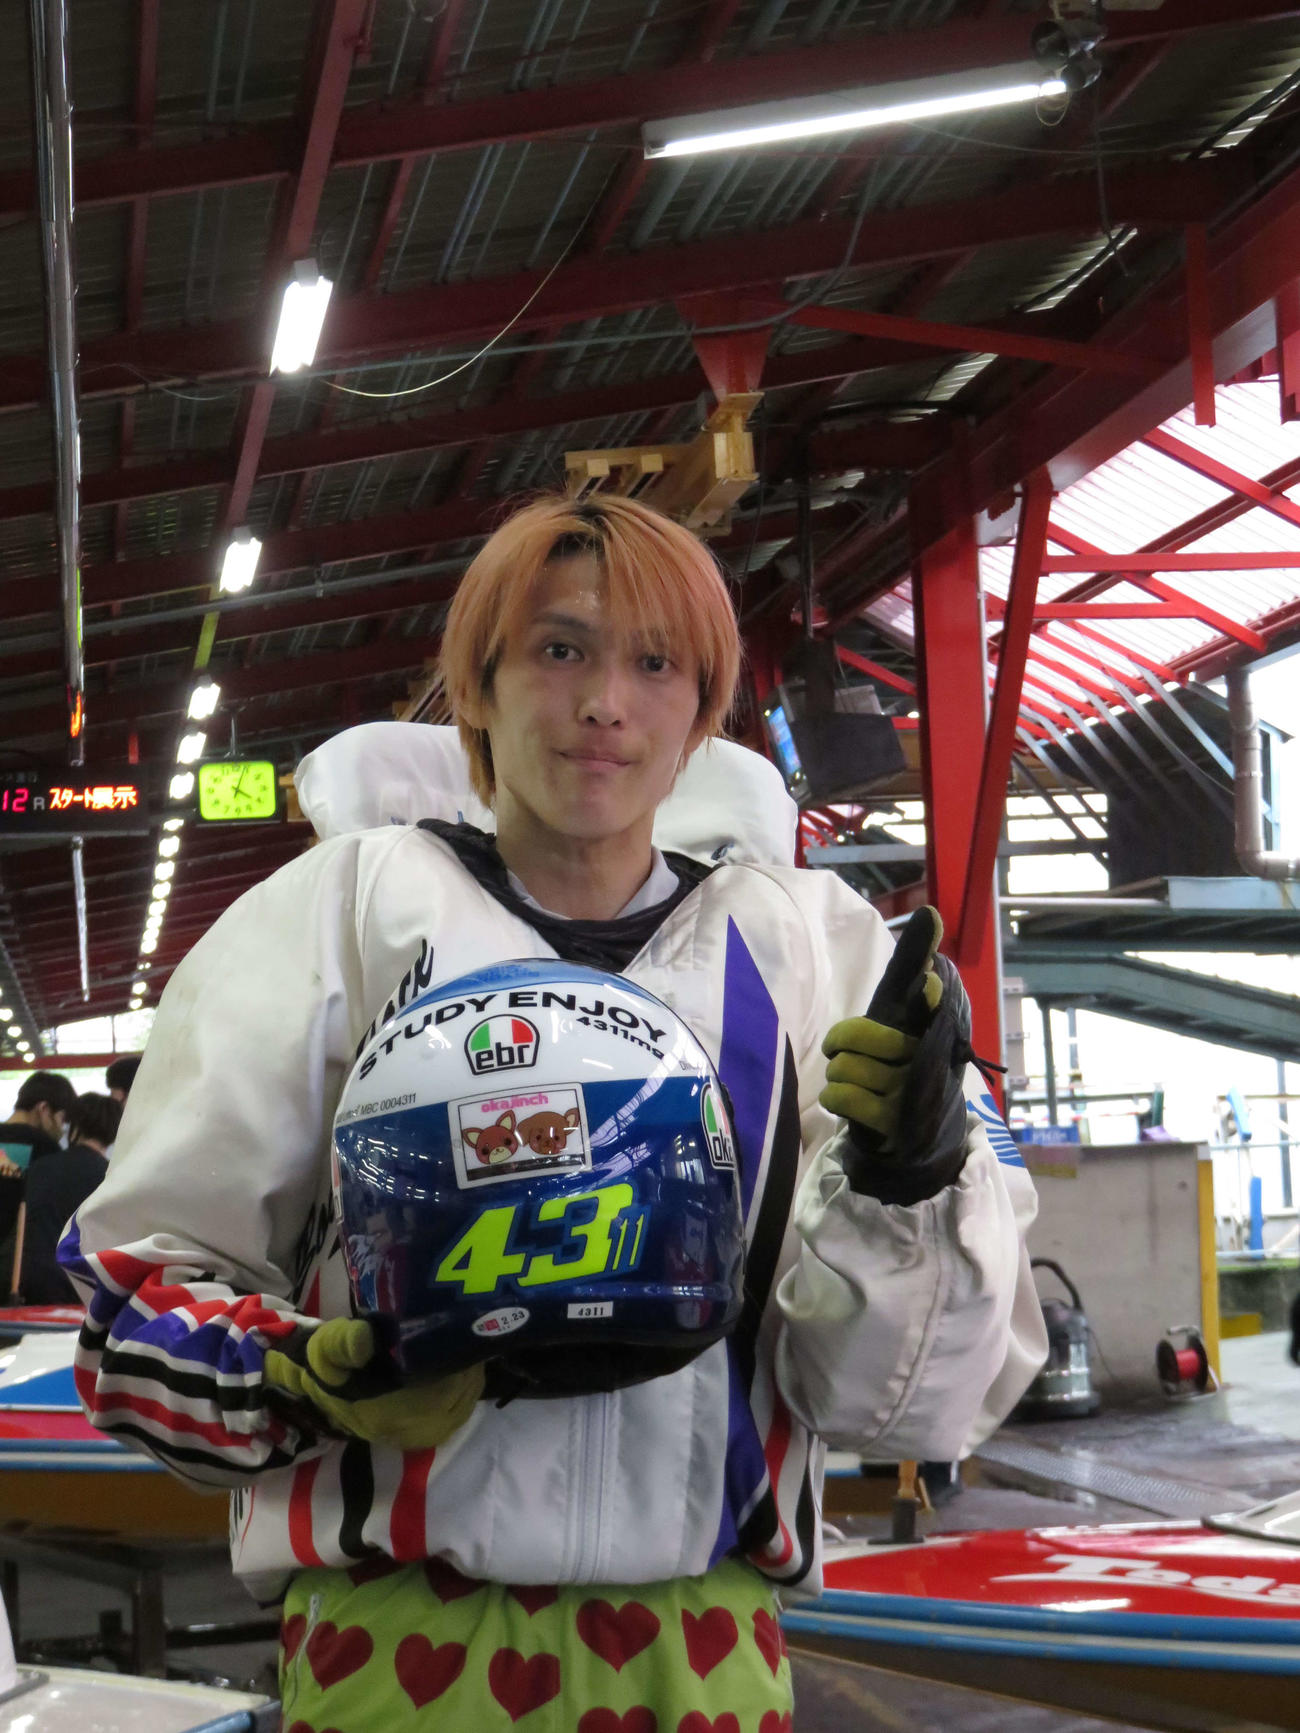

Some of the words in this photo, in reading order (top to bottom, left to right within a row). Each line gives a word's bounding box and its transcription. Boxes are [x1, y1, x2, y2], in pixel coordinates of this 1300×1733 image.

[2, 788, 29, 812] 12
[359, 994, 498, 1080] STUDY
[508, 991, 667, 1043] ENJOY
[475, 1042, 530, 1071] ebr
[481, 1093, 549, 1113] okajinch
[578, 1306, 604, 1317] 4311
